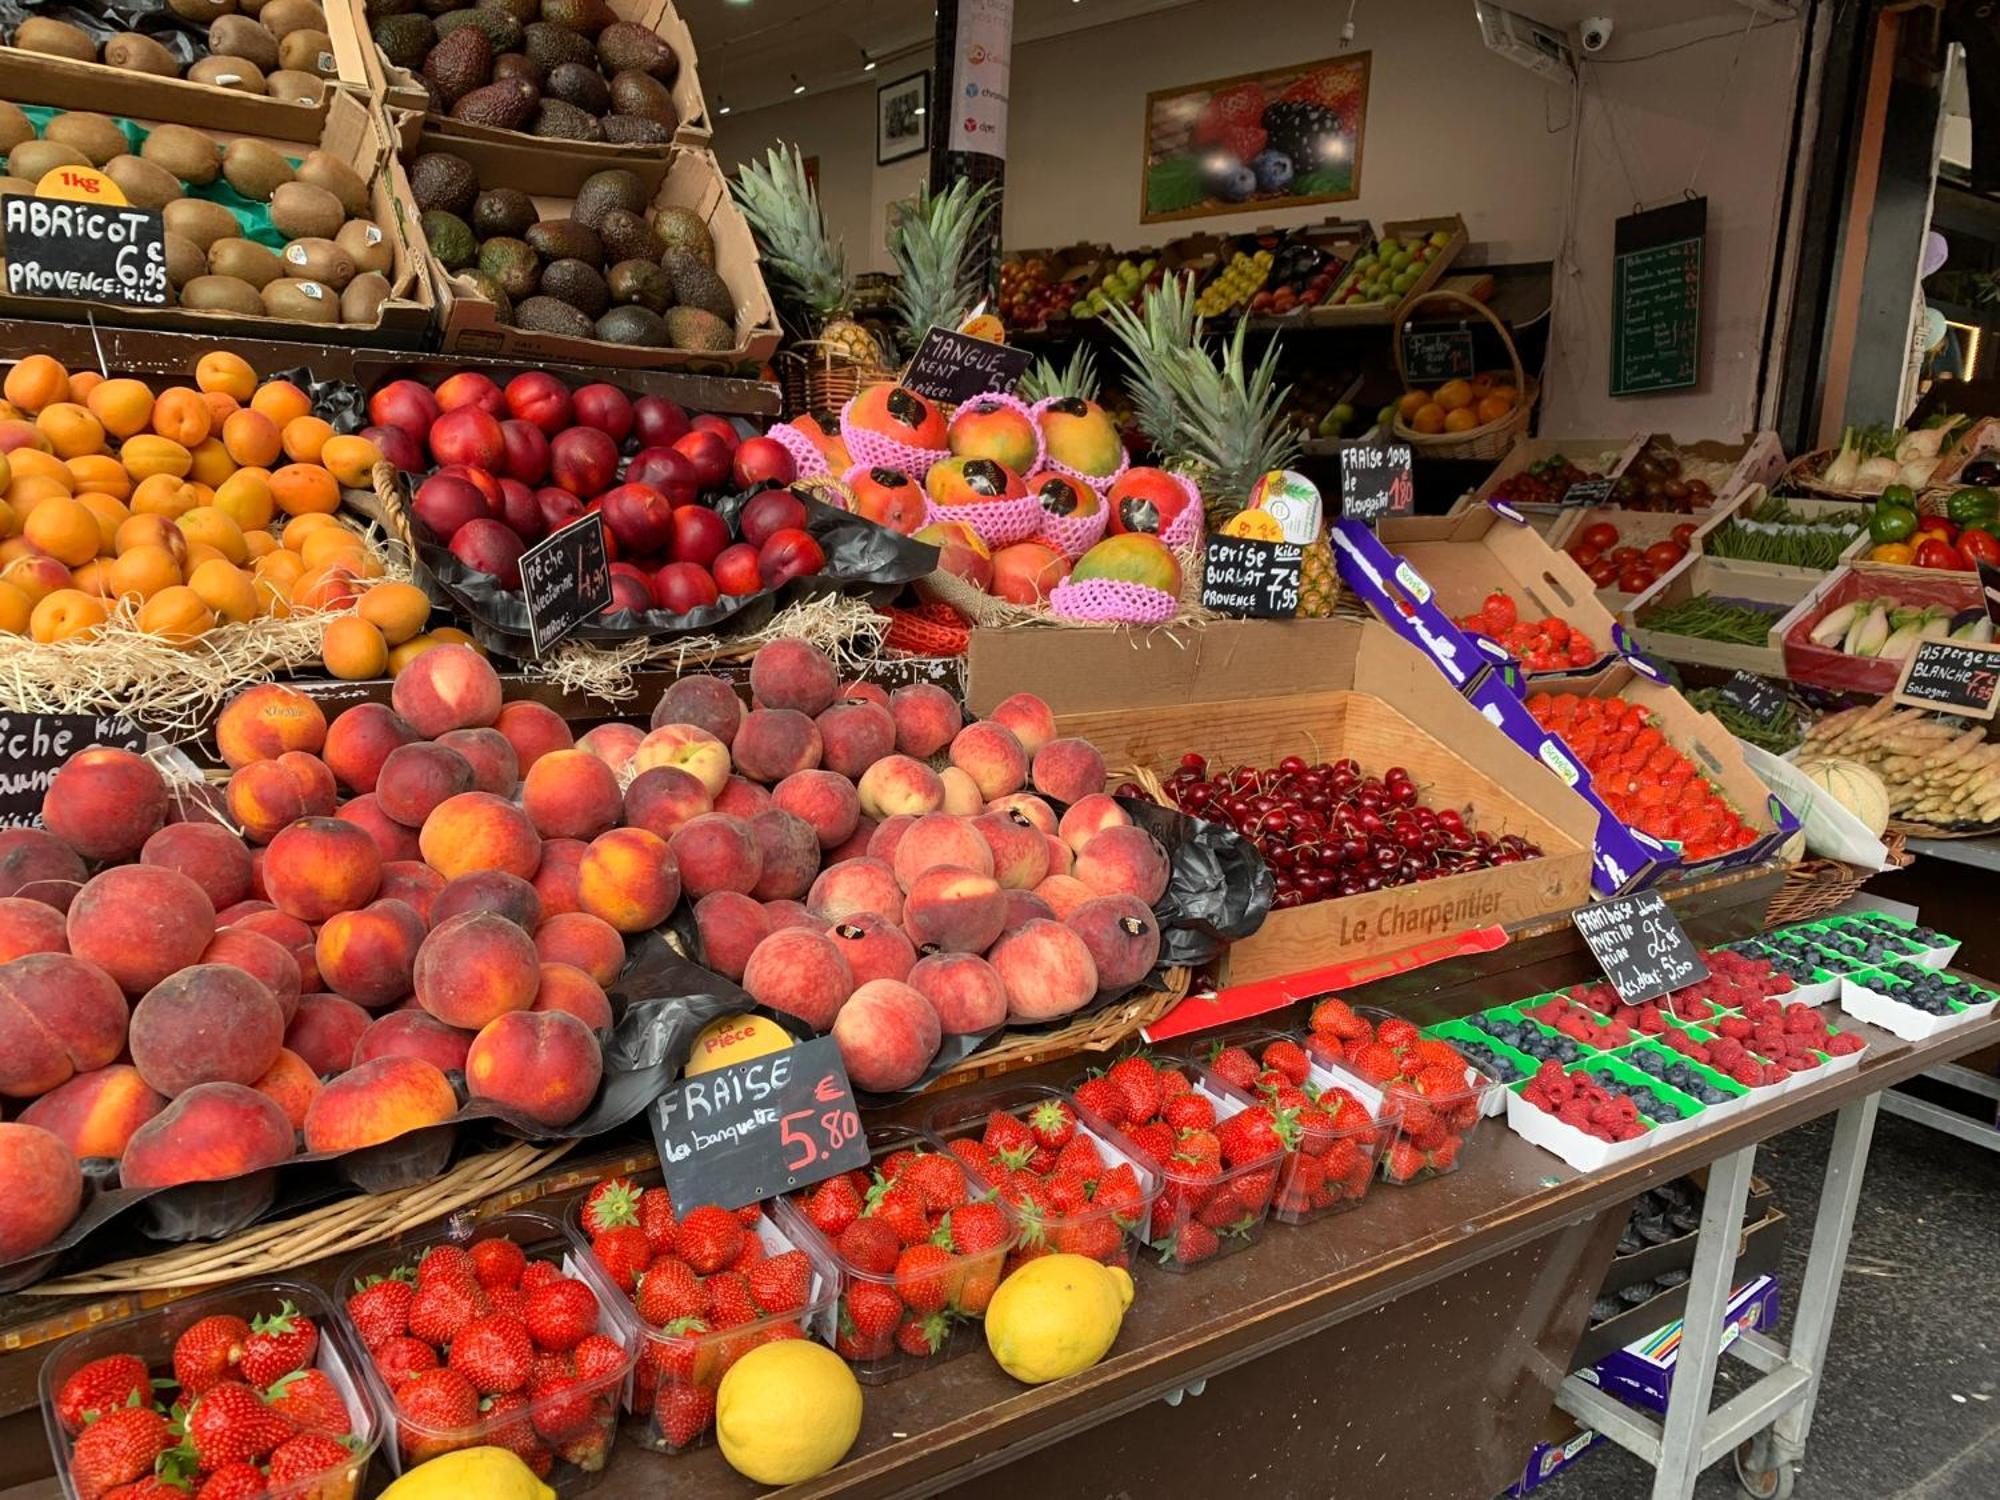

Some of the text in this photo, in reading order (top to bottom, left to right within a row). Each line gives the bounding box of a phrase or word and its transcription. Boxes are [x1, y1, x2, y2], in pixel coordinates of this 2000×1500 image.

[60, 172, 100, 193] 1kg
[925, 333, 1006, 373] MANGUE
[916, 357, 960, 379] KENT
[1345, 470, 1357, 491] de
[1206, 565, 1266, 587] BURLAT
[1203, 589, 1256, 607] PROVENCE
[1339, 889, 1503, 947] Le Charpentier
[704, 1025, 756, 1054] Pièce
[719, 1024, 734, 1035] La
